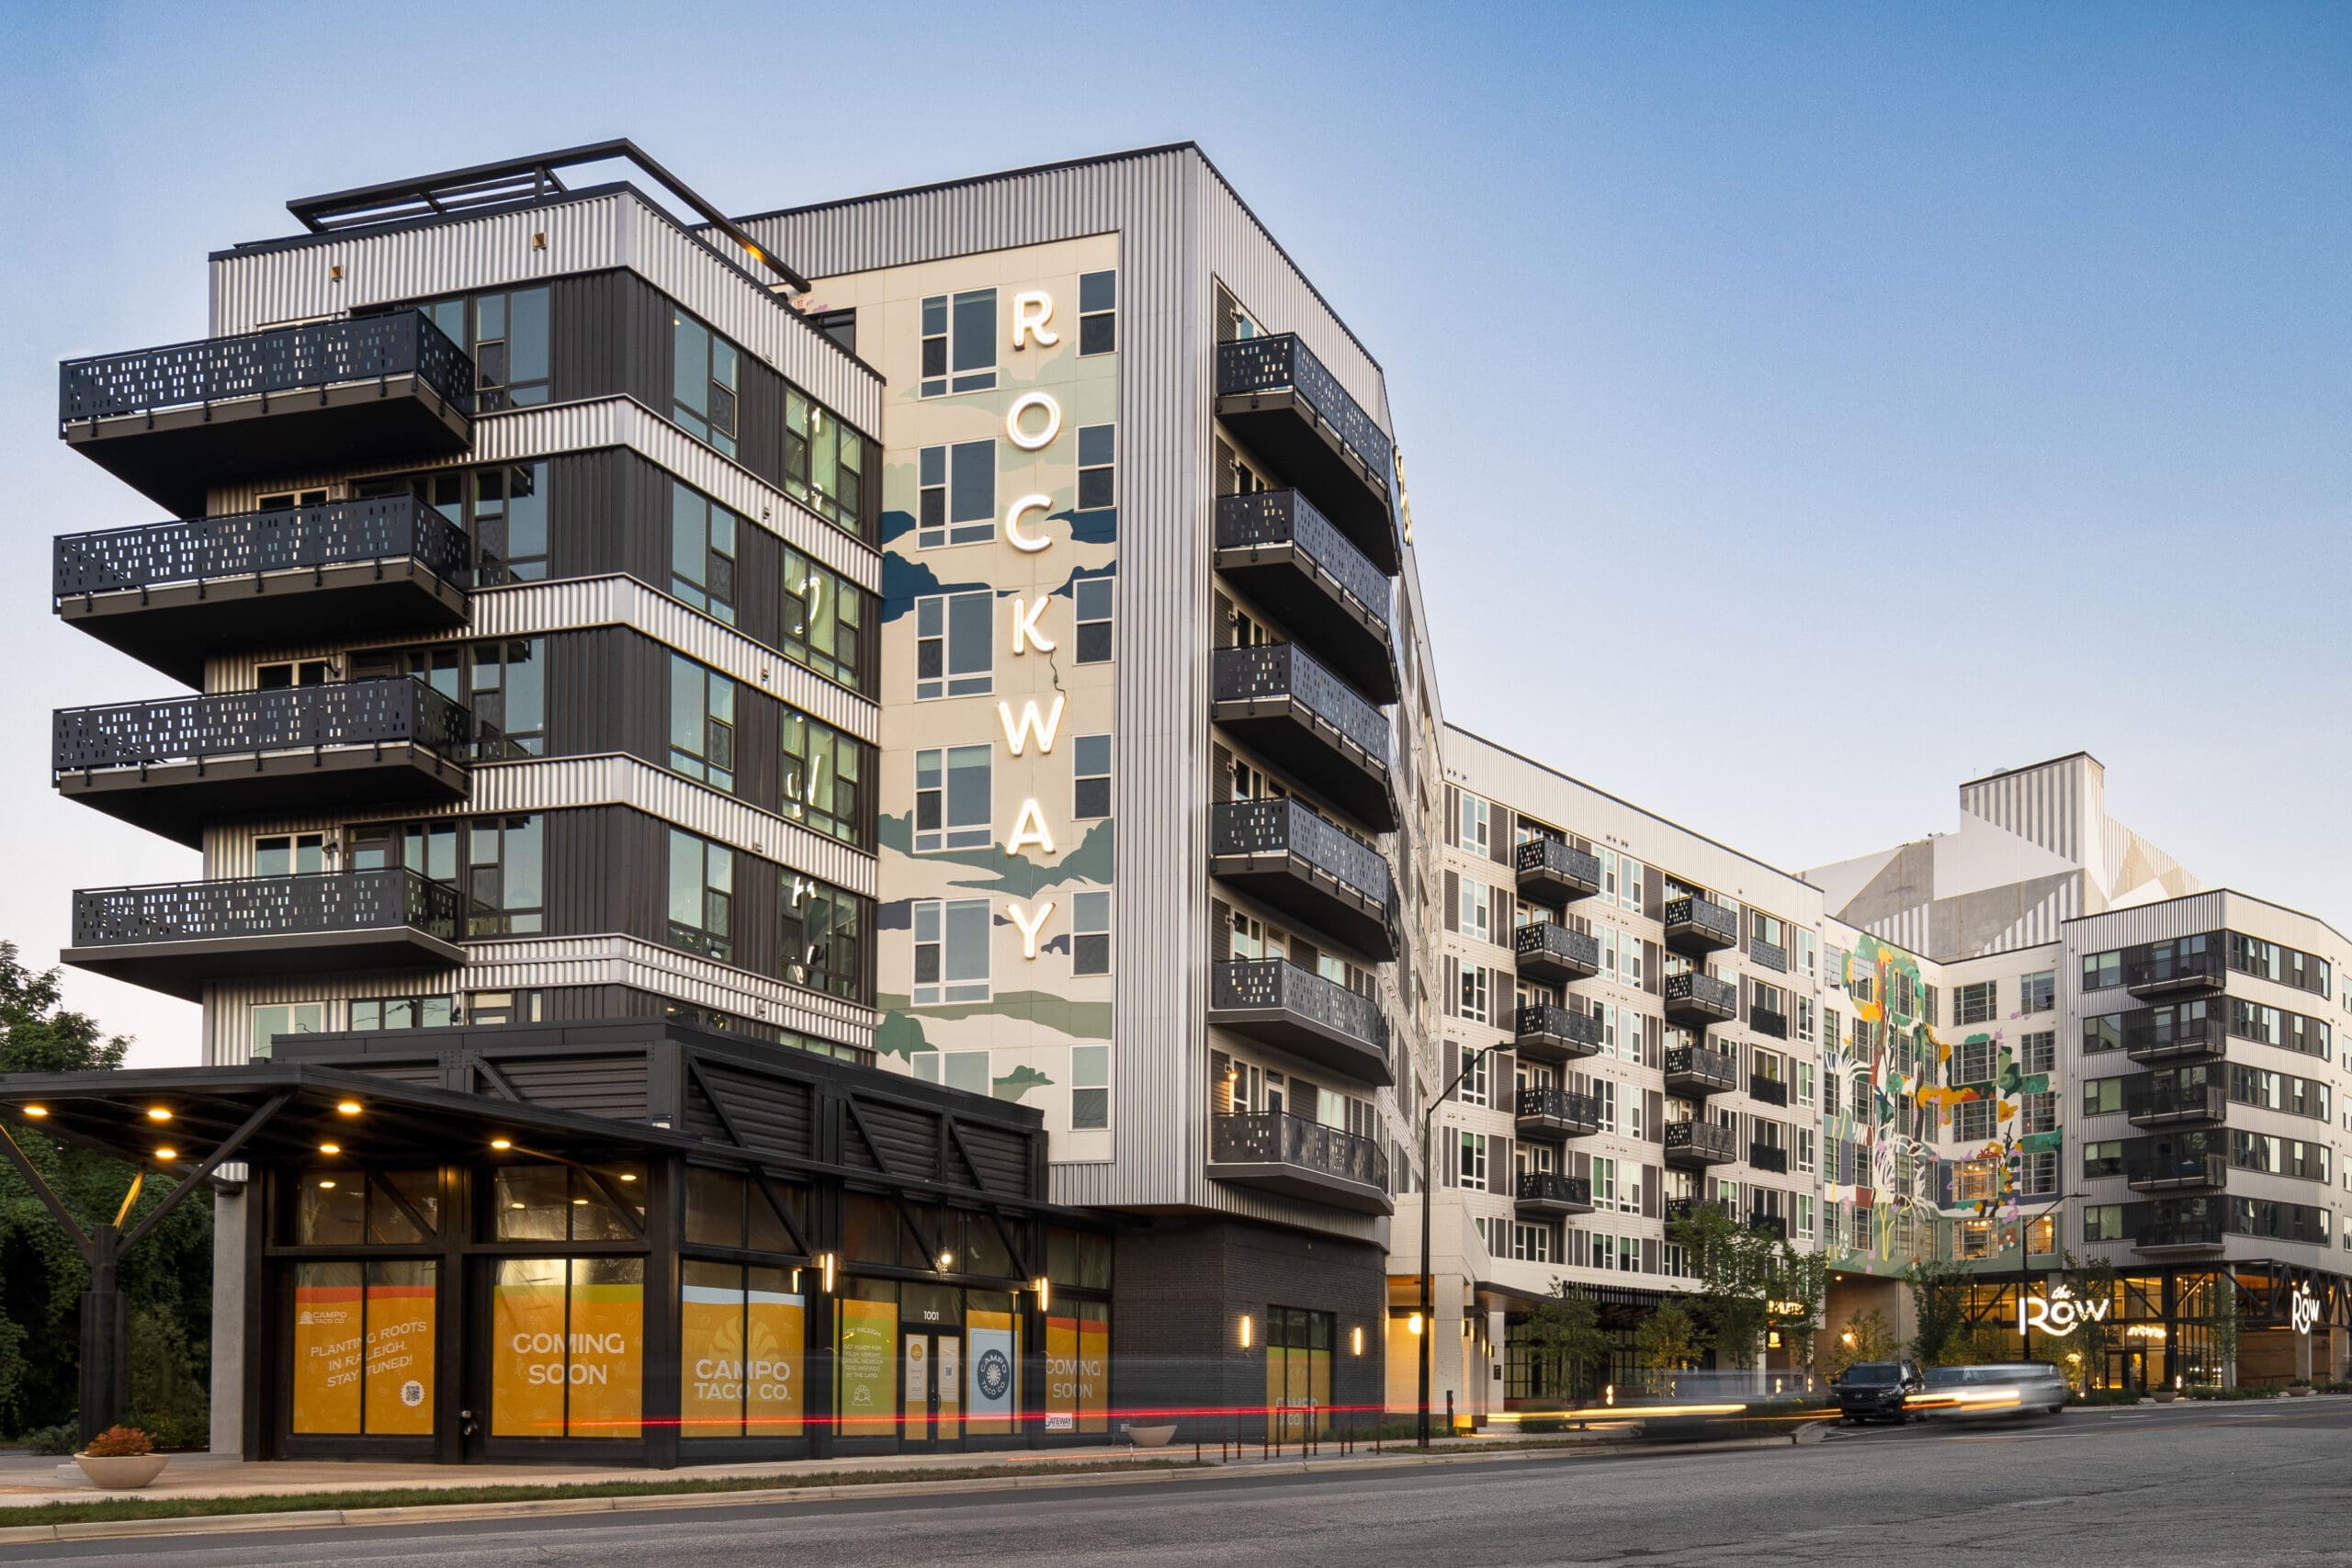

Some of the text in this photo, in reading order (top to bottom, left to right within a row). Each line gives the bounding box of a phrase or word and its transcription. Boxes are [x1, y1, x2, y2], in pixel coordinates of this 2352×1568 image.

[996, 289, 1067, 961] ROCKWAY
[312, 1311, 347, 1319] CAMPO
[923, 1310, 939, 1321] 1001
[311, 1321, 428, 1358] PLANTING ROOTS
[513, 1333, 625, 1354] COMING
[327, 1355, 413, 1387] STAY TUNED!
[328, 1359, 342, 1371] IN
[695, 1359, 791, 1382] CAMPO
[980, 1355, 1007, 1373] CAMPO
[528, 1363, 606, 1385] SOON
[693, 1382, 792, 1400] TACO CO.
[981, 1379, 996, 1395] TACO
[1052, 1382, 1093, 1399] SOON
